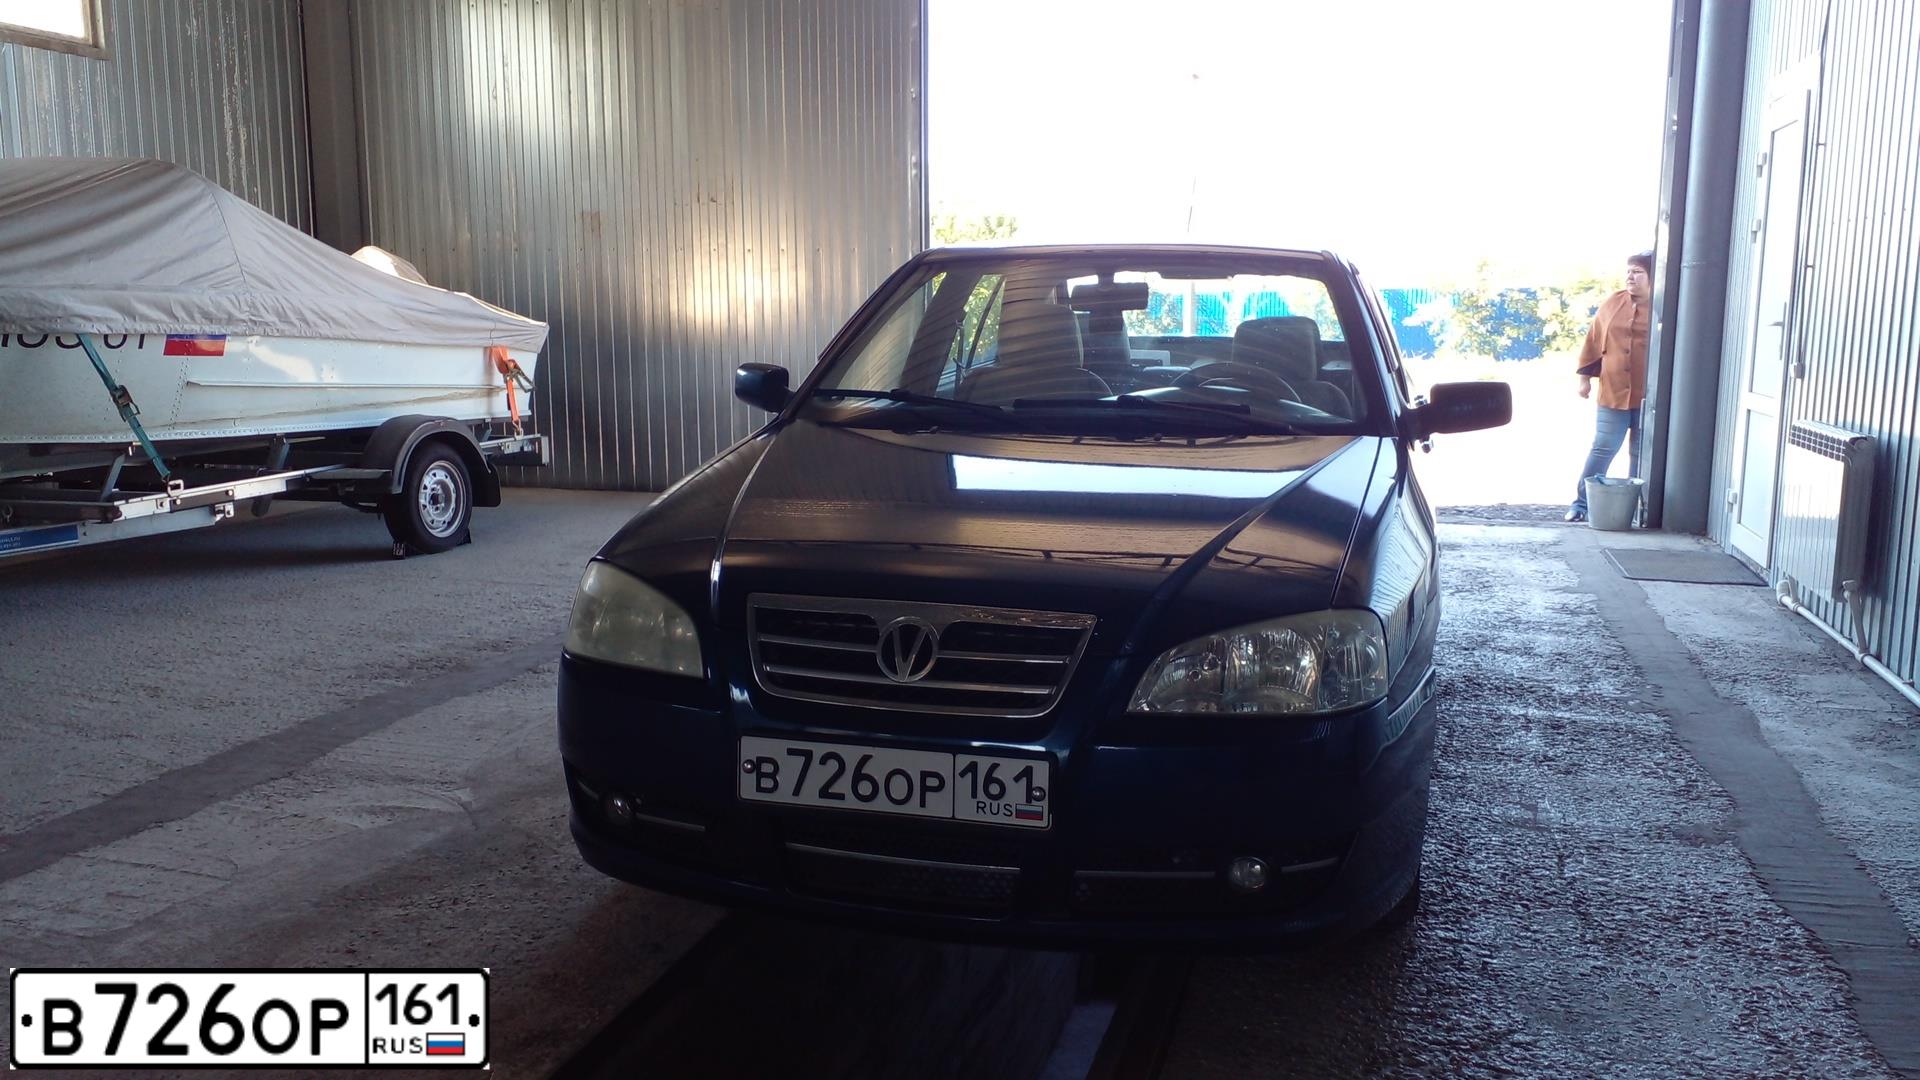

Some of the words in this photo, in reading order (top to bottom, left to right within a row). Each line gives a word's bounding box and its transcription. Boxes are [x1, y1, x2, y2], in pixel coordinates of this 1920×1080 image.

[755, 747, 946, 809] В726ОР
[958, 760, 1034, 804] 161
[976, 801, 1013, 818] RUS
